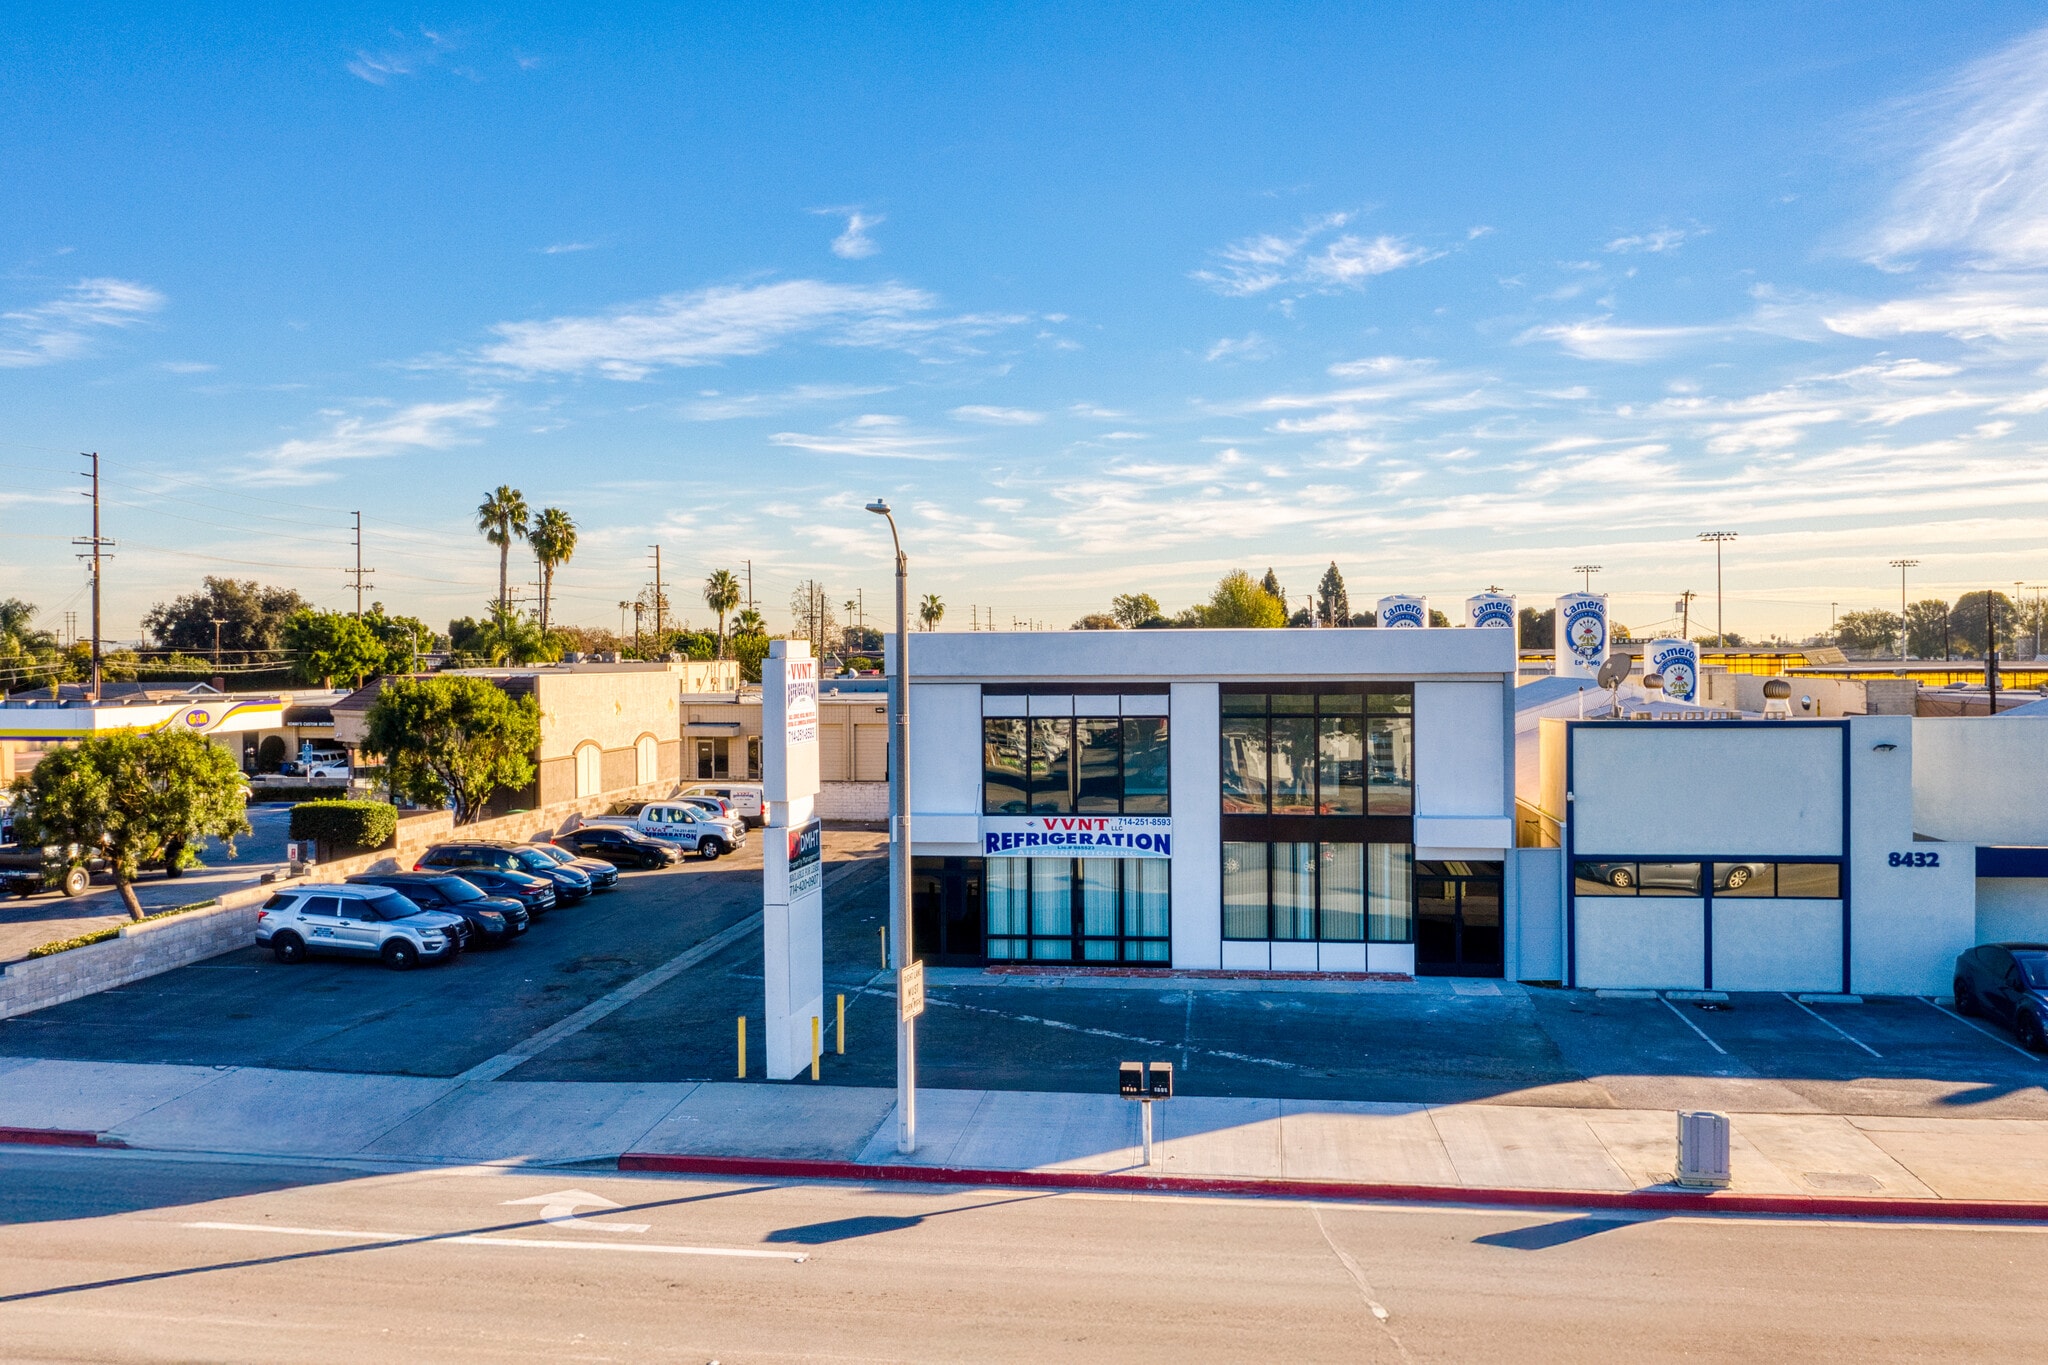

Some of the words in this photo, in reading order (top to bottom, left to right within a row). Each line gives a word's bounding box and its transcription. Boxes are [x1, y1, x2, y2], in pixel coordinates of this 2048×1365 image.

[790, 663, 812, 680] VVNT
[1043, 818, 1110, 831] VVNT
[1118, 818, 1171, 826] 714-251-8593
[800, 829, 819, 852] DMHT
[985, 832, 1171, 856] REFRIGERATION
[1888, 852, 1940, 867] 8432
